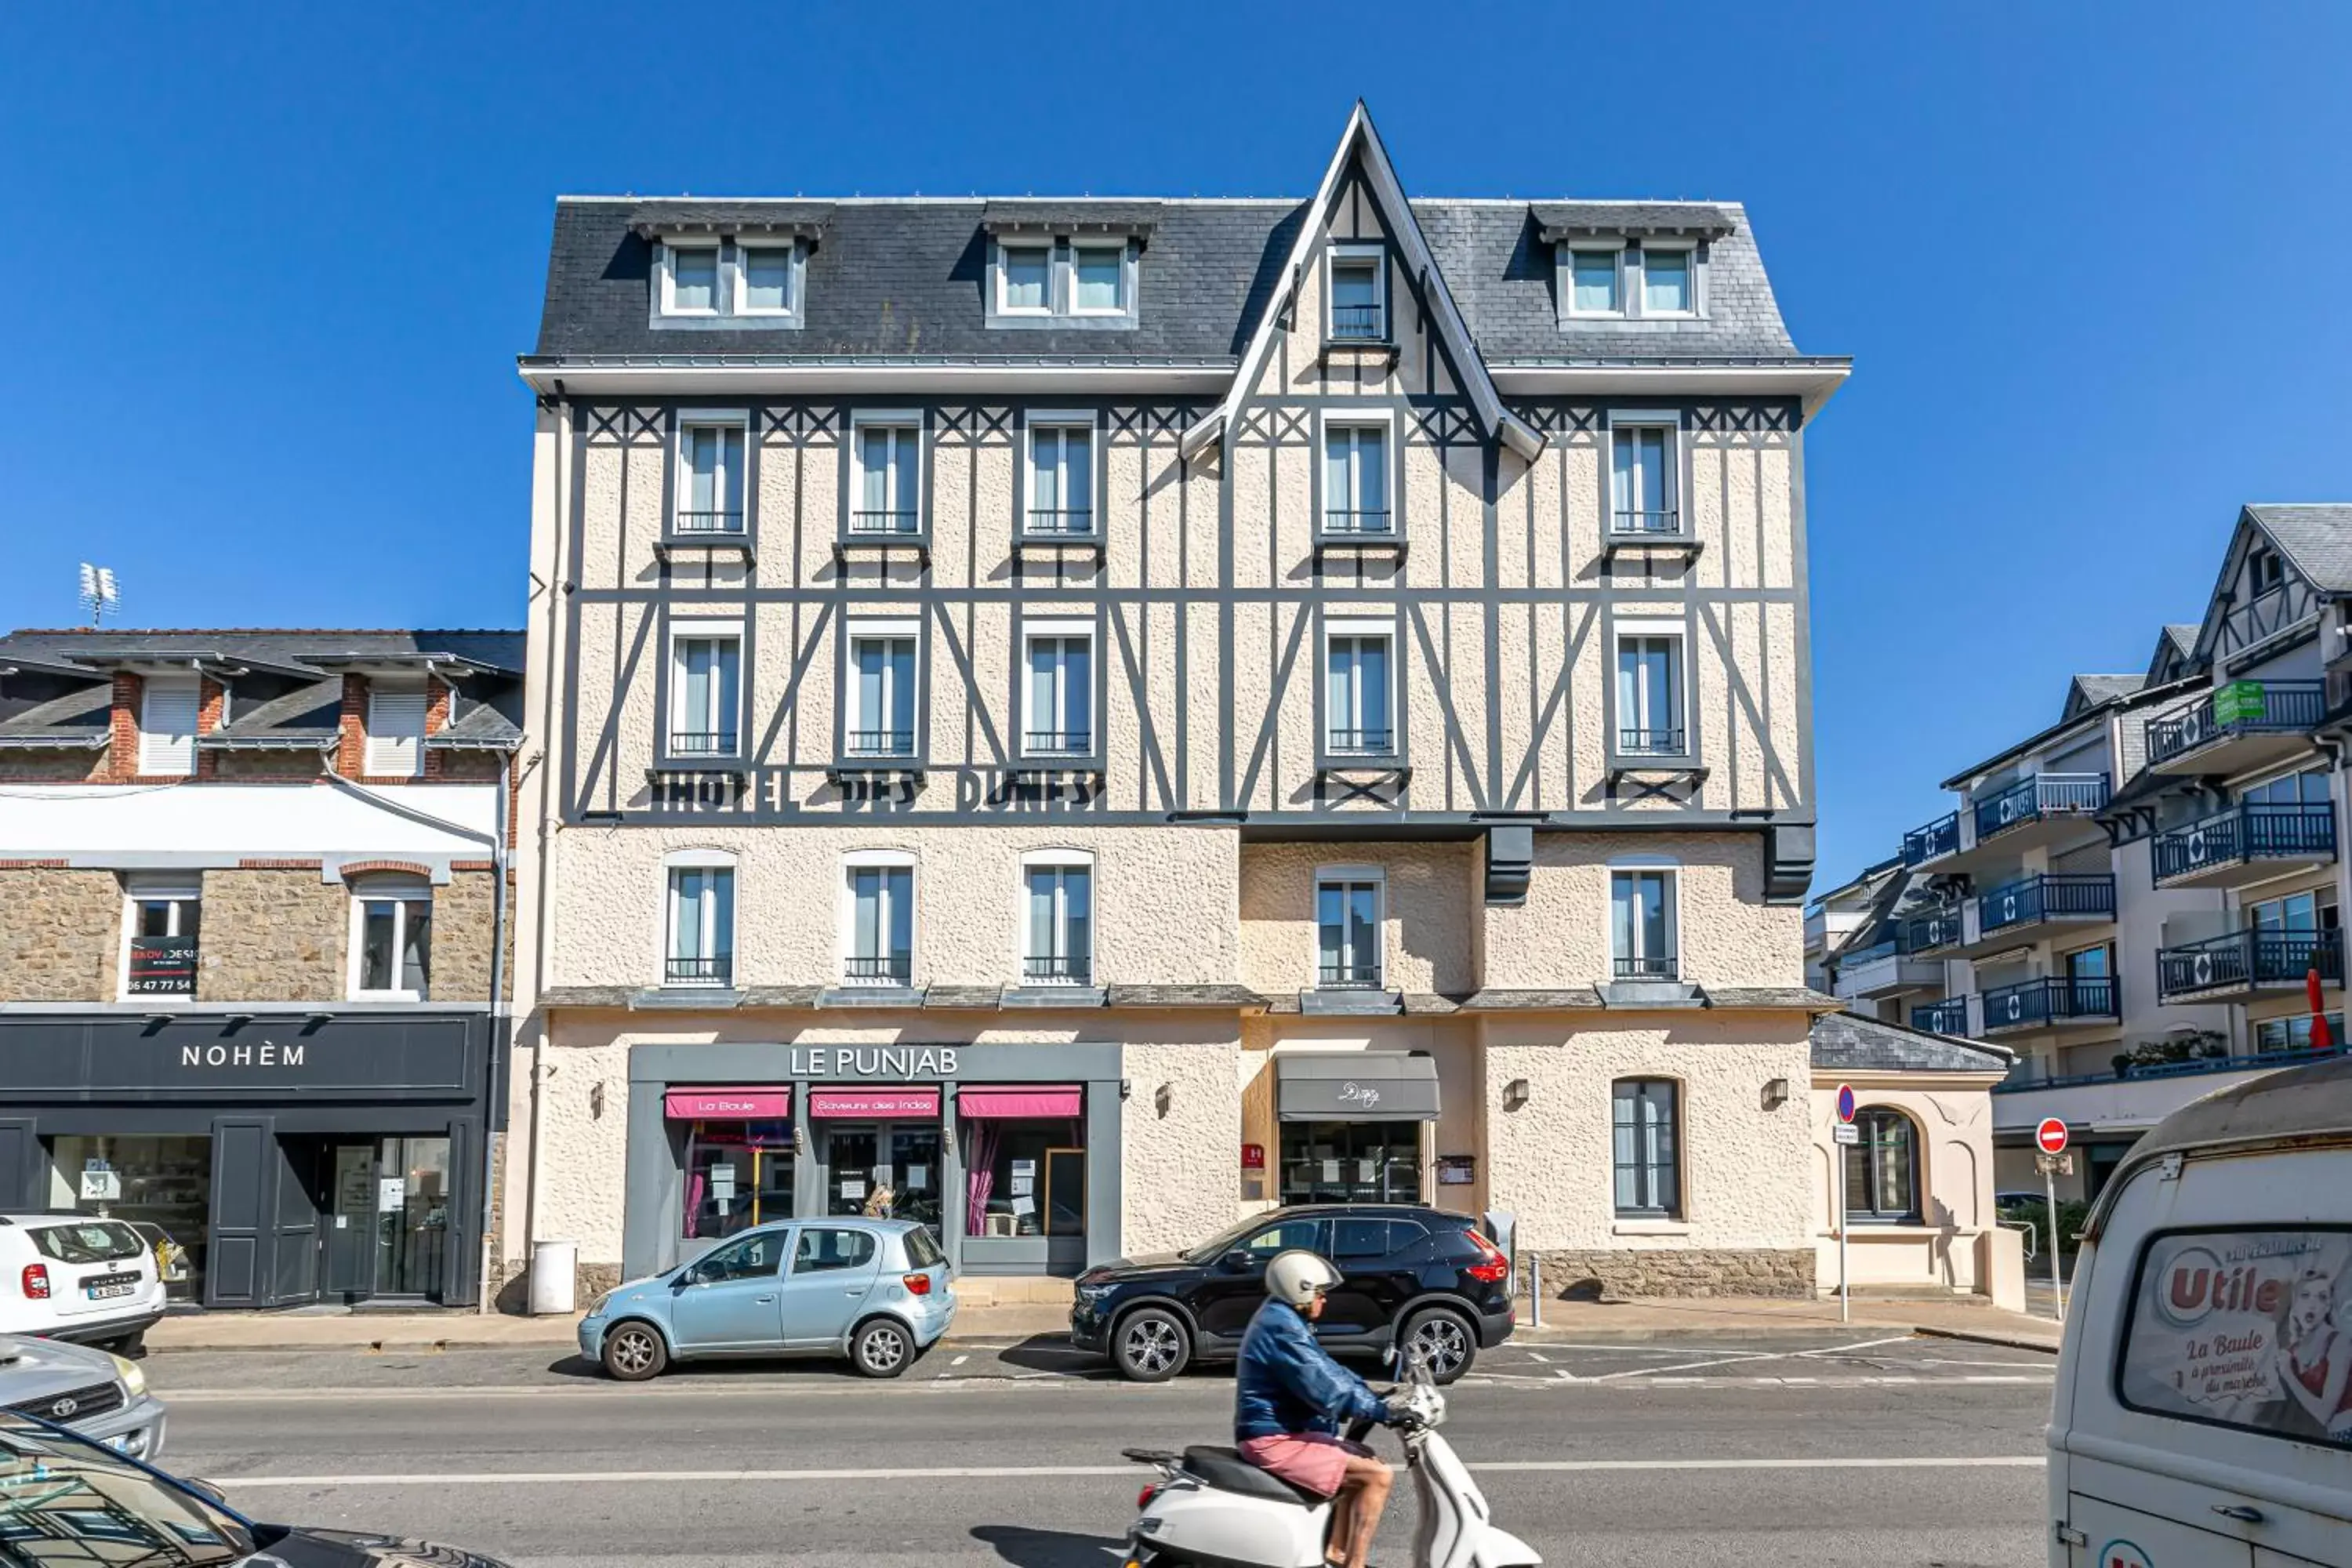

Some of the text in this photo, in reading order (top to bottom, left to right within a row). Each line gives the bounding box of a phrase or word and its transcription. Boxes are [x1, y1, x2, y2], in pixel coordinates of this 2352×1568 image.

[956, 770, 1093, 812] DUNES
[142, 980, 158, 991] 47
[159, 979, 174, 990] 77
[181, 1040, 304, 1066] NOHÈM
[791, 1047, 958, 1080] LE PUNJAB
[2171, 1265, 2281, 1313] Utile
[2187, 1329, 2263, 1360] La Baule
[2205, 1377, 2220, 1393] du
